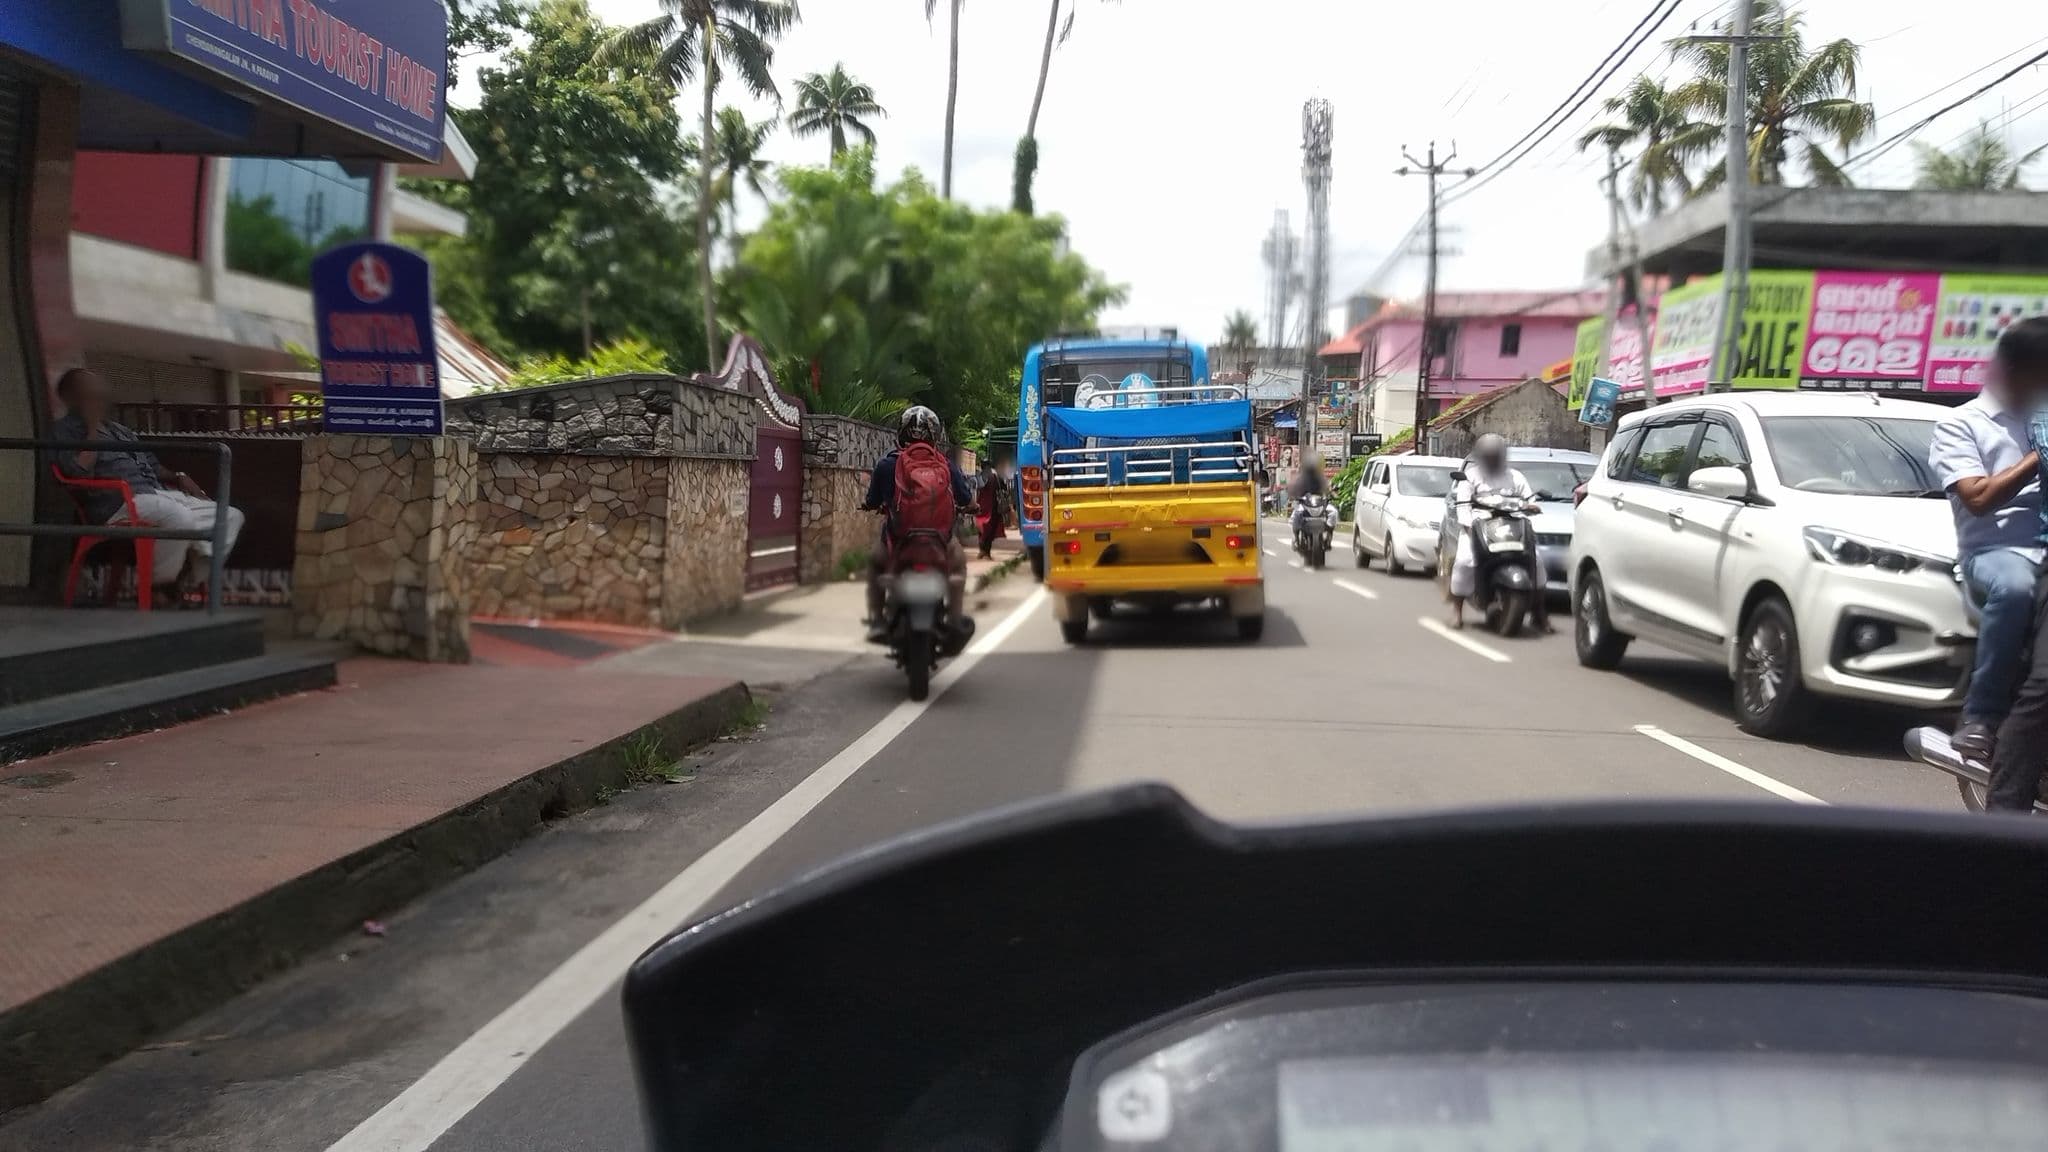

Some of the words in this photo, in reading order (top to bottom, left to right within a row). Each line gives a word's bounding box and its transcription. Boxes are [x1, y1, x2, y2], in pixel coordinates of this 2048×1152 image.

[187, 0, 288, 50] THA
[289, 0, 384, 96] TOURIST
[384, 47, 438, 123] HOME
[1736, 285, 1806, 313] ACTORY
